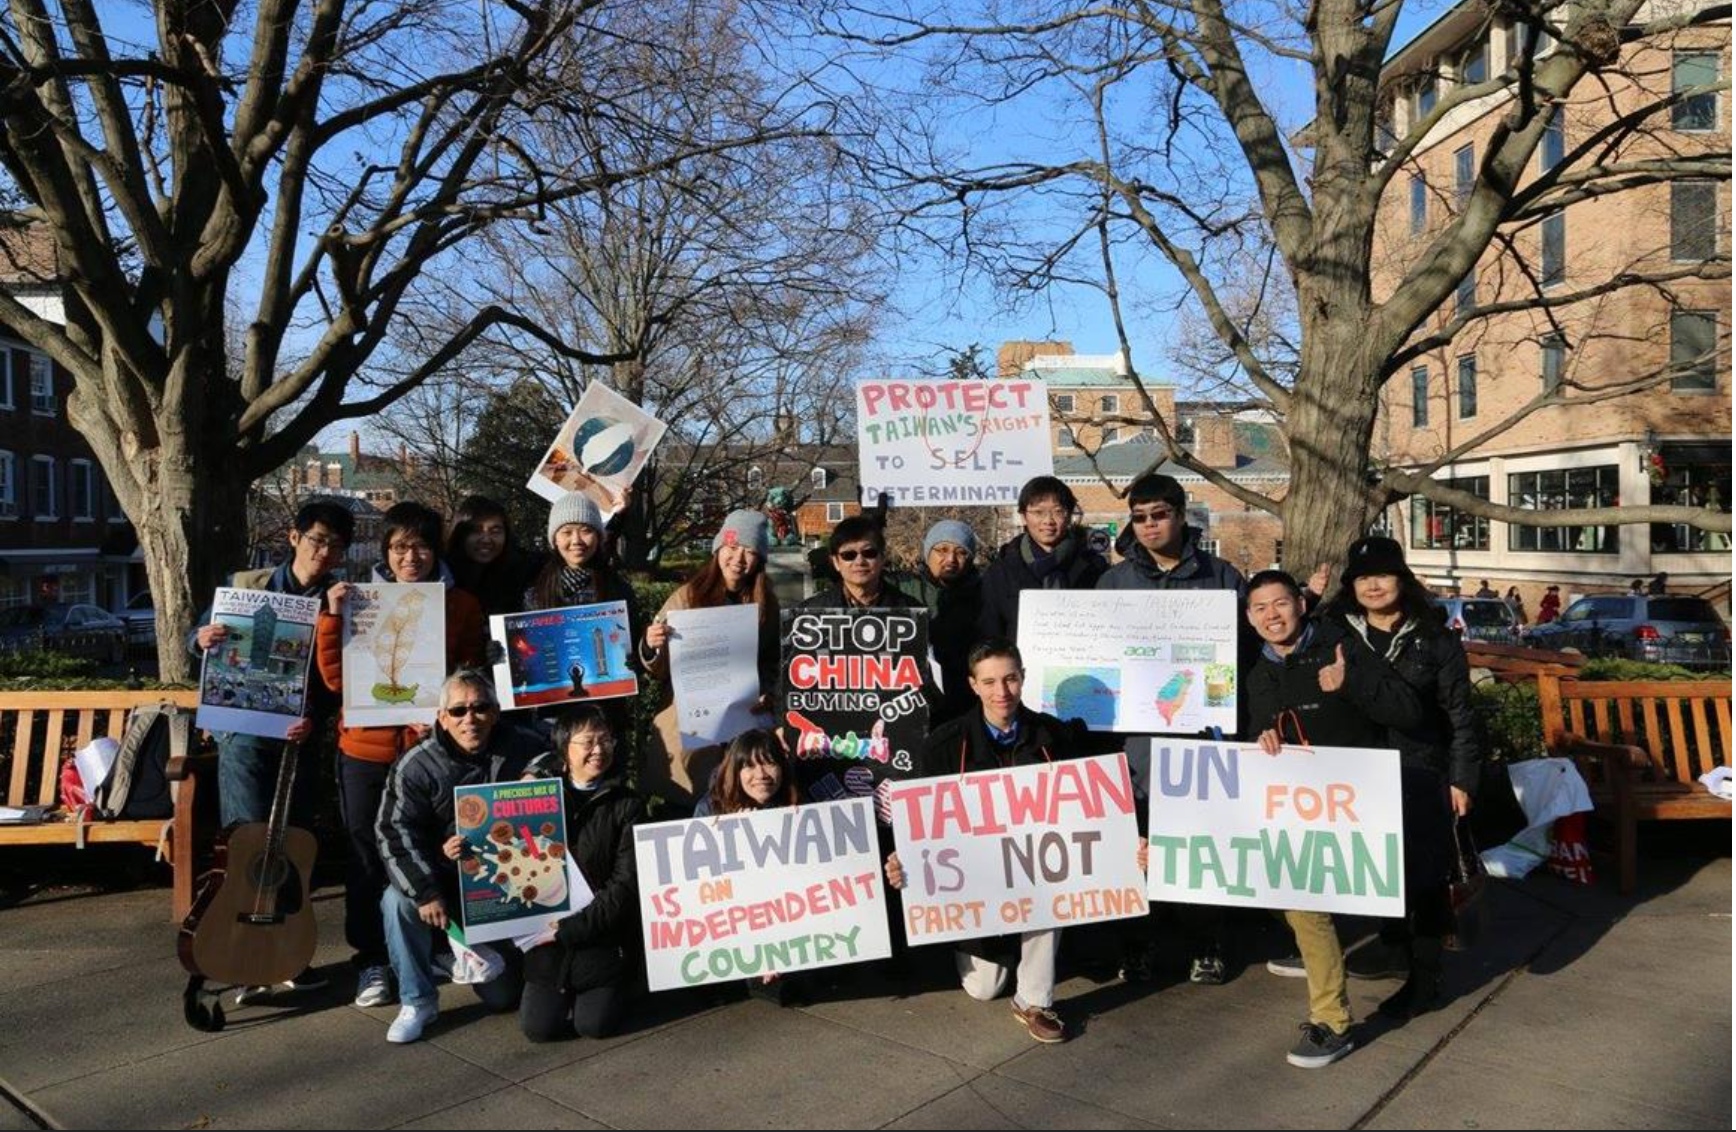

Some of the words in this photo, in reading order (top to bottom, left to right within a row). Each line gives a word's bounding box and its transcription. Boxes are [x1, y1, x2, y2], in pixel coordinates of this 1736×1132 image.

[862, 383, 1031, 415] PROTECT
[866, 413, 978, 444] TAIWAN'S
[981, 415, 1042, 435] RIGHT
[876, 455, 904, 470] TO
[930, 448, 1023, 471] SELF-
[867, 485, 1018, 502] DETERMINATI
[220, 591, 317, 611] TAIWANESE
[792, 615, 917, 651] STOP
[1124, 645, 1161, 657] acer
[789, 655, 923, 689] CHINA
[787, 692, 880, 711] BUYING
[879, 688, 927, 722] OUT
[893, 750, 912, 771] &
[1160, 745, 1240, 800] UN
[493, 790, 499, 799] A
[499, 787, 534, 799] PRECIOUS
[534, 785, 548, 795] MIX
[549, 784, 557, 794] OF
[493, 796, 559, 818] CULTURES
[891, 753, 1136, 841] TAIWAN
[1266, 783, 1359, 822] FOR
[637, 803, 871, 886] TAIWAN
[1001, 831, 1102, 888] NOT
[1150, 828, 1400, 898] TAIWAN
[650, 872, 876, 950] INDEPENDENT
[651, 886, 682, 918] IS
[699, 879, 734, 904] AN
[908, 901, 986, 935] PART
[1001, 897, 1032, 923] OF
[1053, 887, 1145, 921] CHINA
[681, 925, 861, 984] COUNTRY
